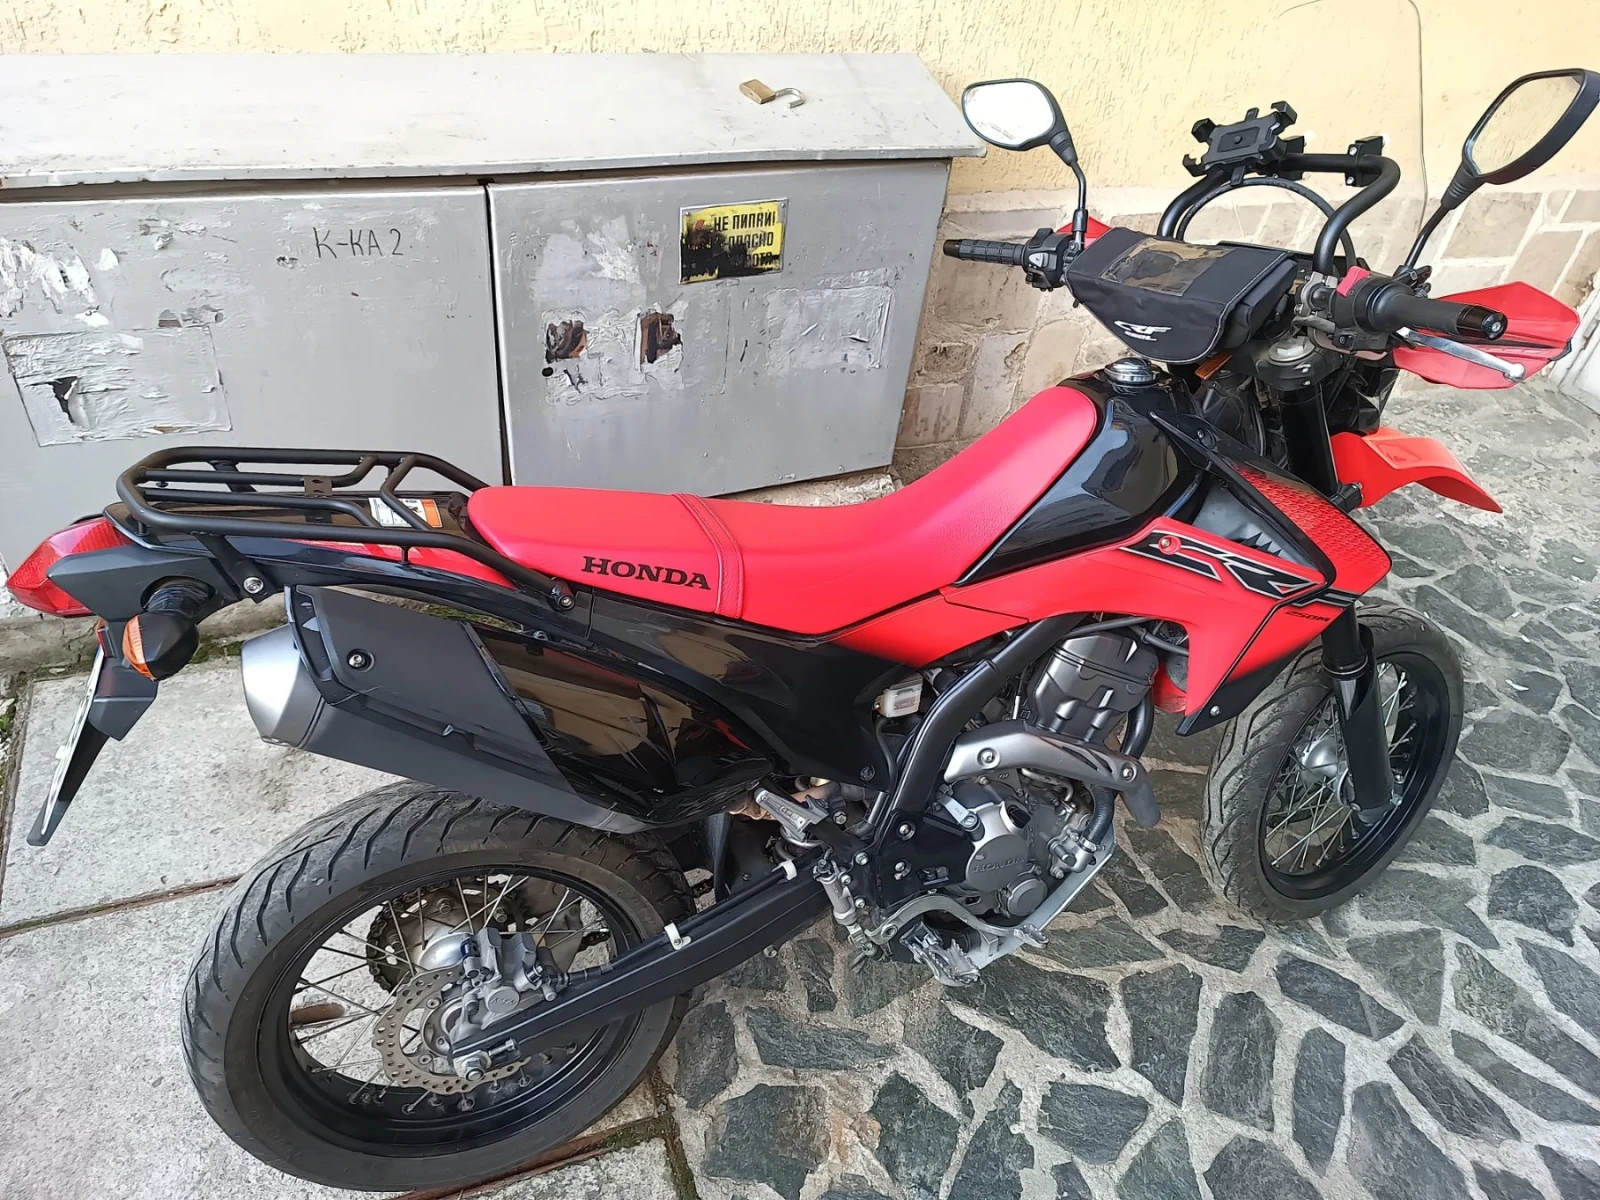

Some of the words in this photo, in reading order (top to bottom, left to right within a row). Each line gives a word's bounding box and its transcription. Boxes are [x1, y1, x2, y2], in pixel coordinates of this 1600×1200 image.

[714, 216, 729, 231] НЕ
[732, 211, 775, 230] ПИПАЙ!
[581, 555, 711, 590] HONDA
